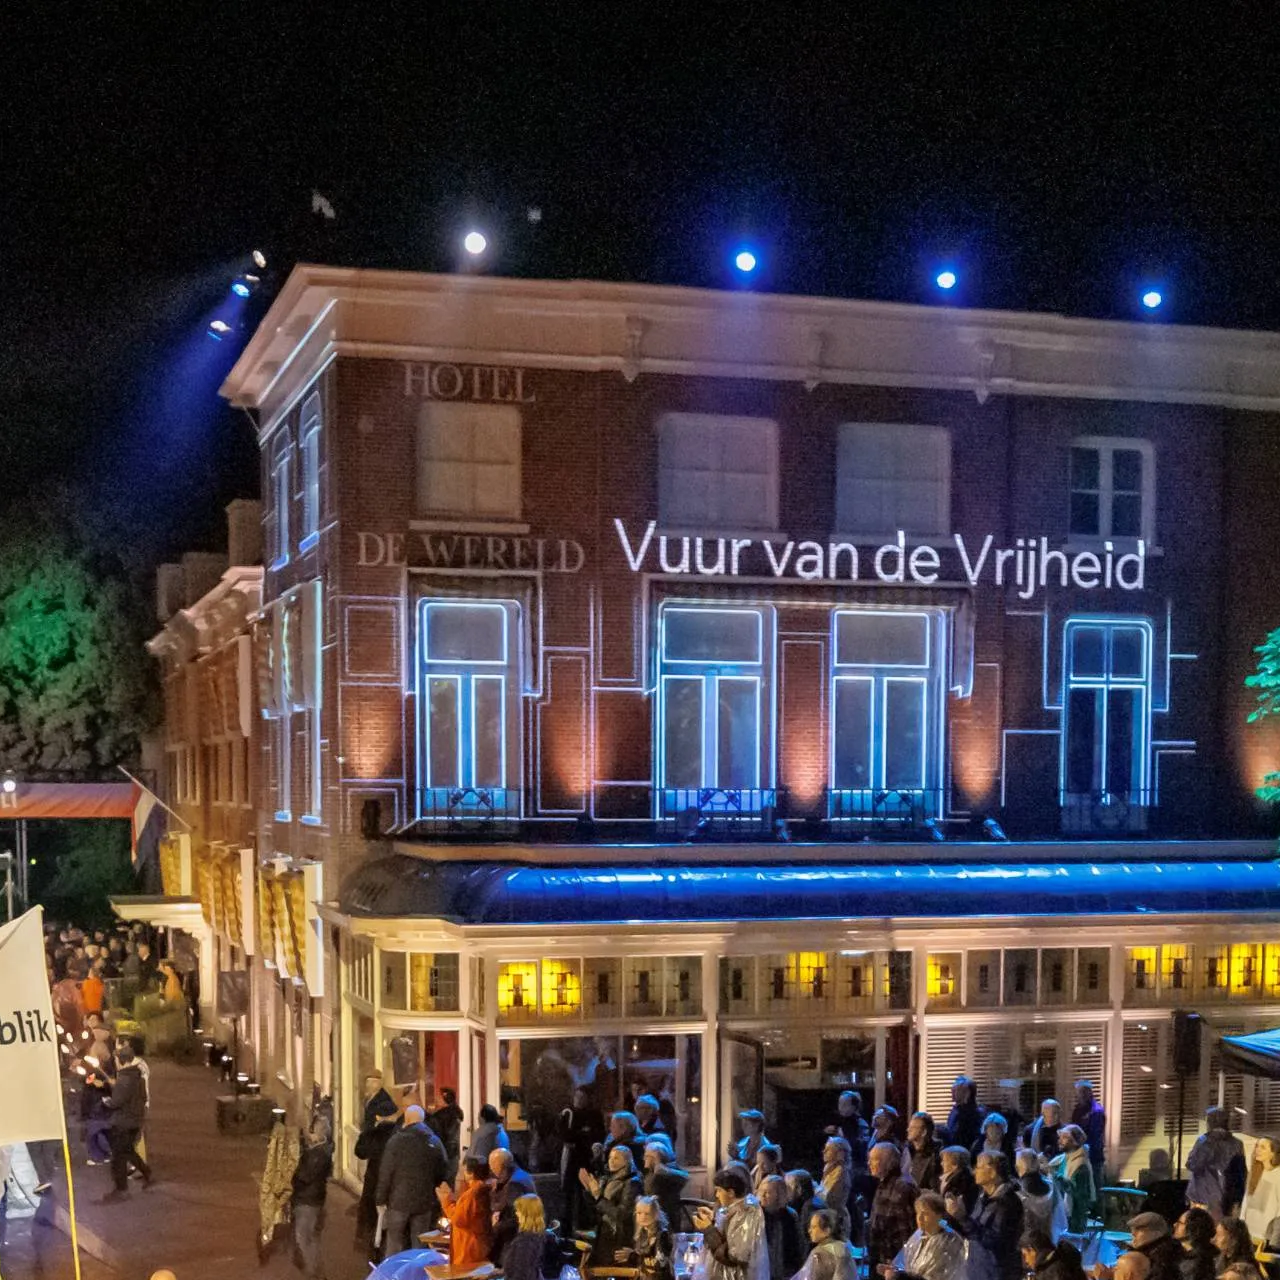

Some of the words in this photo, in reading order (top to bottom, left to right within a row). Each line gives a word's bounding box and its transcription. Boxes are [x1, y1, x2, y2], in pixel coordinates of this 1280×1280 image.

[402, 362, 536, 403] HOTEL
[356, 531, 408, 567] DE
[422, 534, 586, 574] WERELD
[613, 517, 751, 575] Vuur
[762, 539, 859, 582] van
[874, 529, 941, 585] de
[952, 533, 1146, 600] Vrijheid
